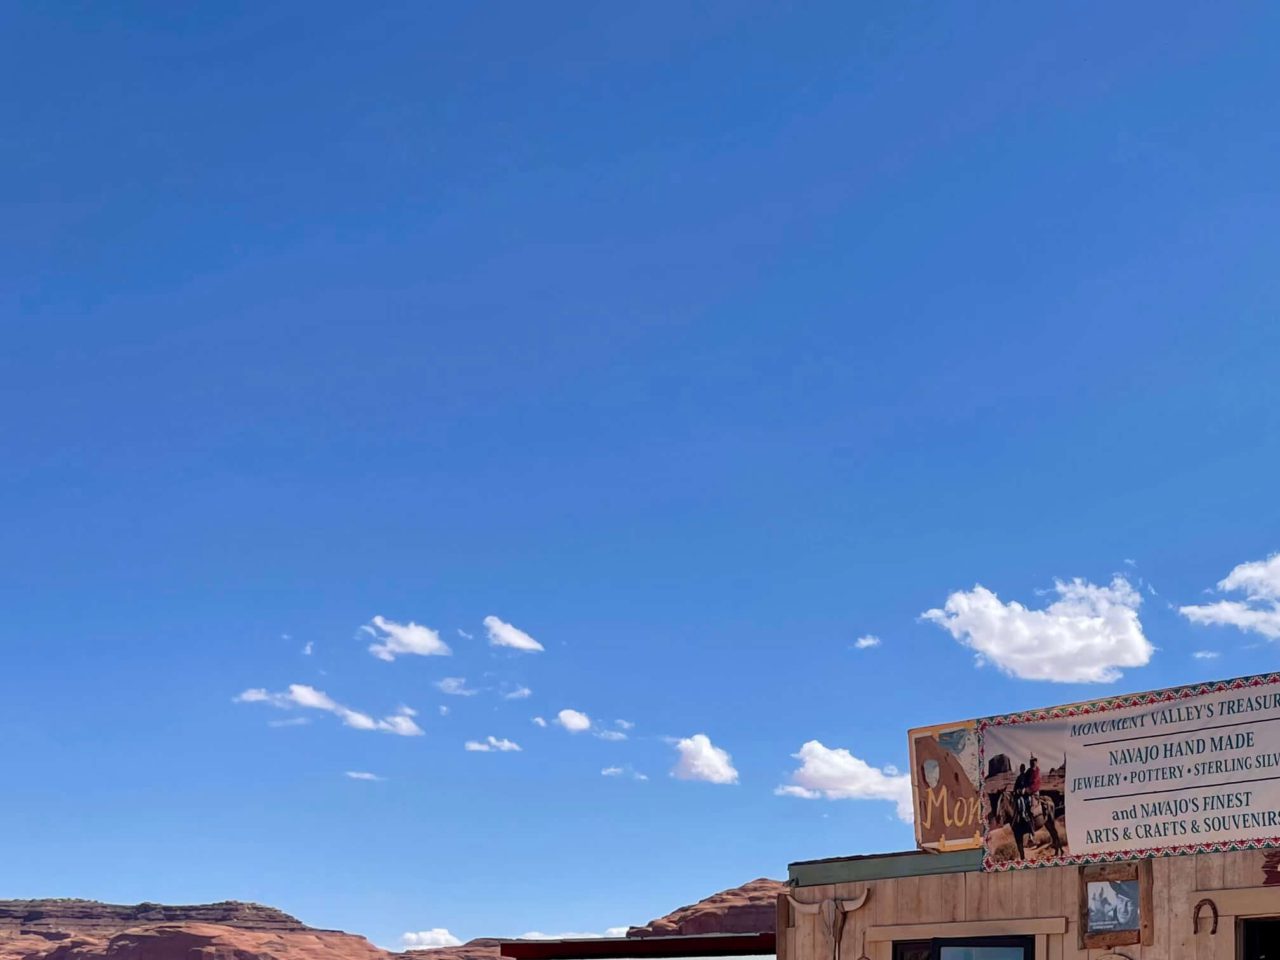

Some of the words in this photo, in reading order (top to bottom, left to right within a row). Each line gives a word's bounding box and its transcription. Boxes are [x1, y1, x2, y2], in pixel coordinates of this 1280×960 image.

[1070, 713, 1148, 737] MONUMENT
[1151, 702, 1214, 725] VALLEY'S
[1109, 745, 1159, 766] NAVAJO
[1163, 738, 1206, 758] HAND
[1210, 731, 1255, 751] MADE
[1071, 772, 1122, 793] JEWELRY
[1129, 764, 1185, 783] POTTERY
[1194, 756, 1252, 776] STERLING
[1111, 804, 1138, 821] and
[1141, 797, 1200, 820] NAVAJO'S
[1203, 791, 1252, 811] FINEST
[1085, 827, 1119, 844] ARTS
[1122, 826, 1132, 840] &
[1135, 820, 1187, 840] CRAFTS
[1190, 818, 1201, 833] &
